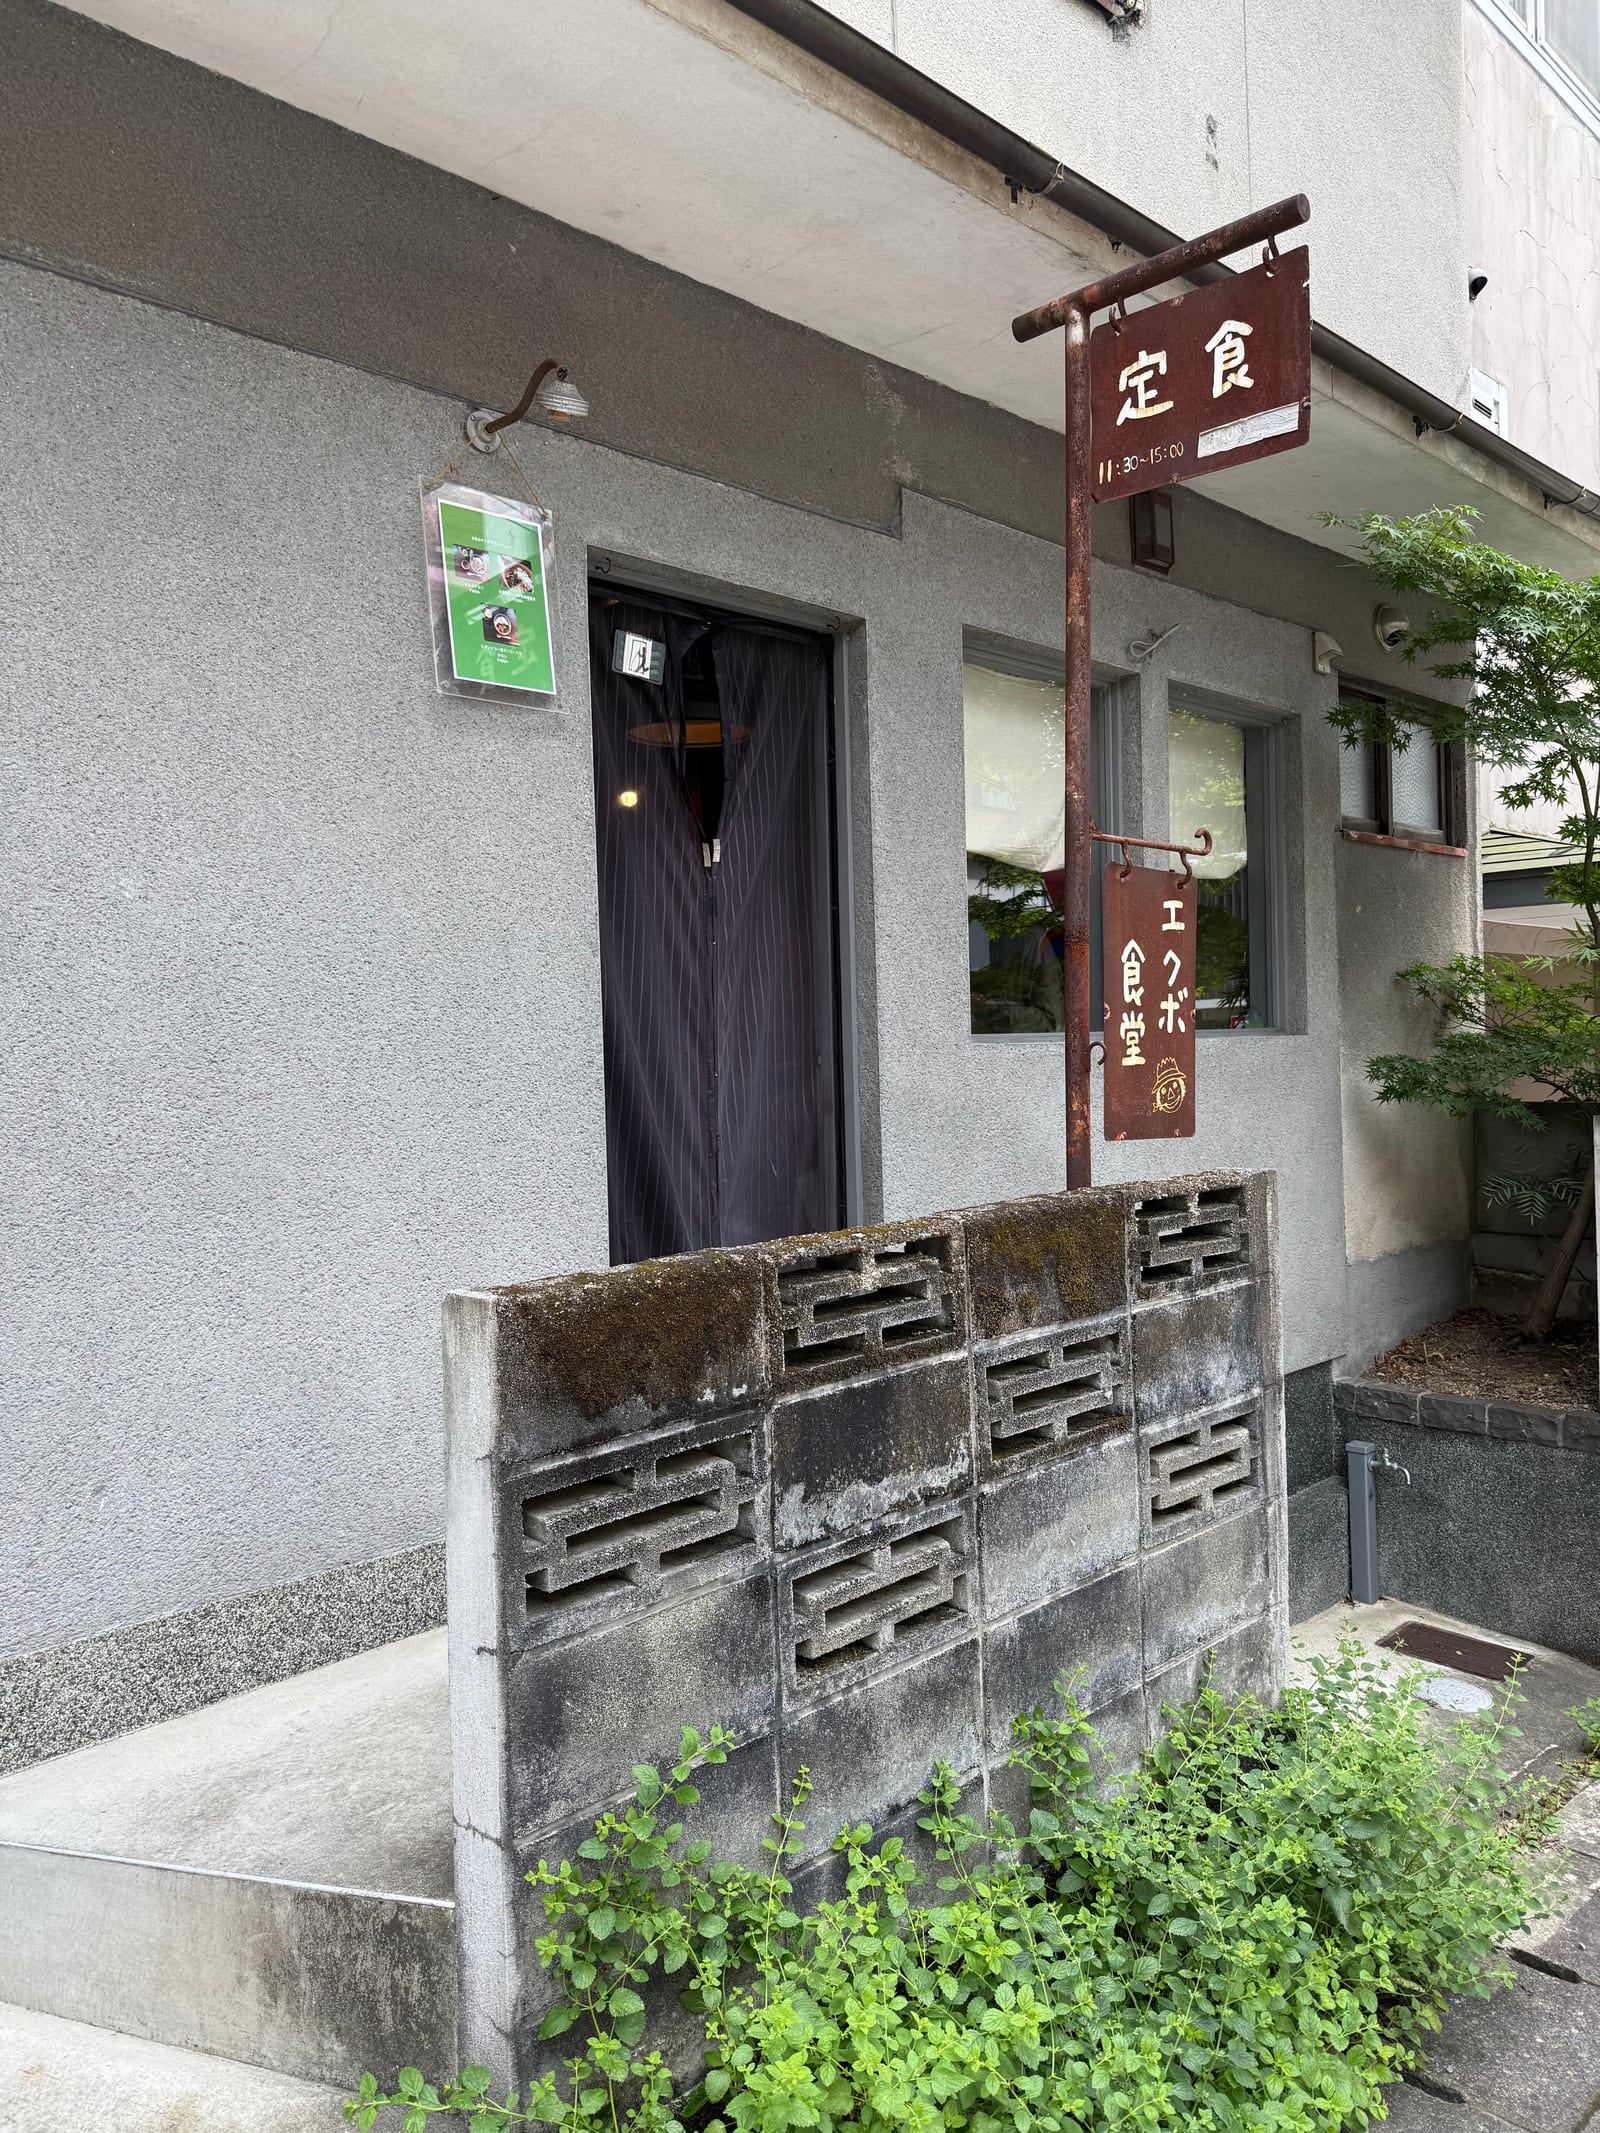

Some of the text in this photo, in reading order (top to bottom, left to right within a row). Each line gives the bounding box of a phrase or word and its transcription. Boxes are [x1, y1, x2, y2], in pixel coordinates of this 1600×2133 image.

[1116, 319, 1255, 426] 定食
[1120, 939, 1147, 1067] 食堂
[1158, 900, 1189, 1034] エクボ
